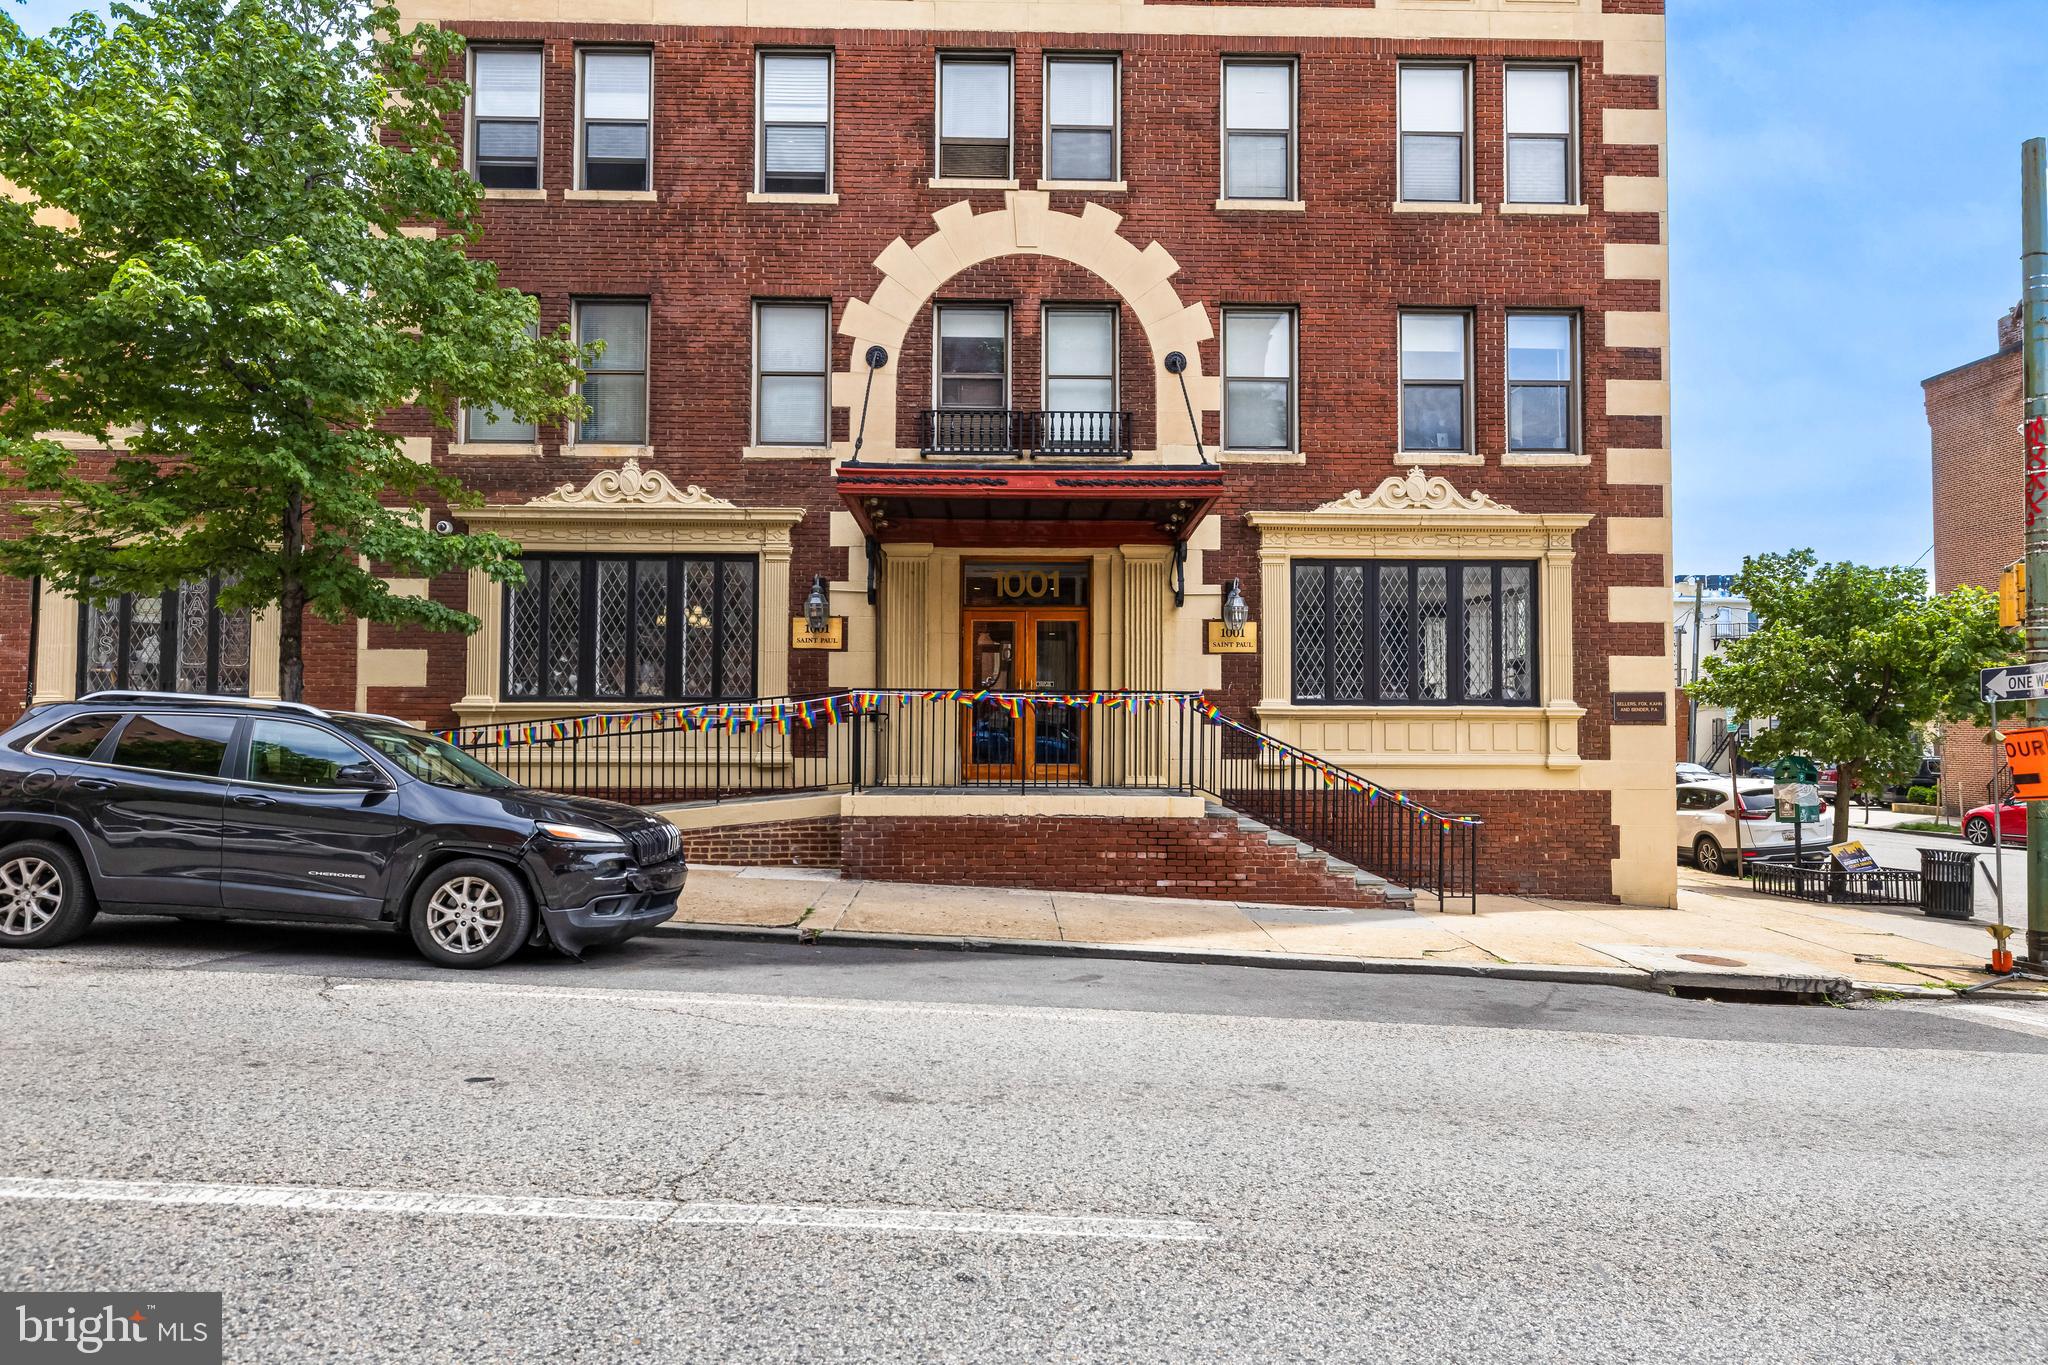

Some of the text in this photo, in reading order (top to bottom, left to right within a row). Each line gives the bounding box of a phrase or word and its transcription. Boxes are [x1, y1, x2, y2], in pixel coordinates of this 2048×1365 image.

[991, 570, 1061, 598] 1001
[1220, 628, 1245, 638] 1001
[2008, 675, 2033, 690] ONE
[308, 870, 366, 879] CHEROKEE
